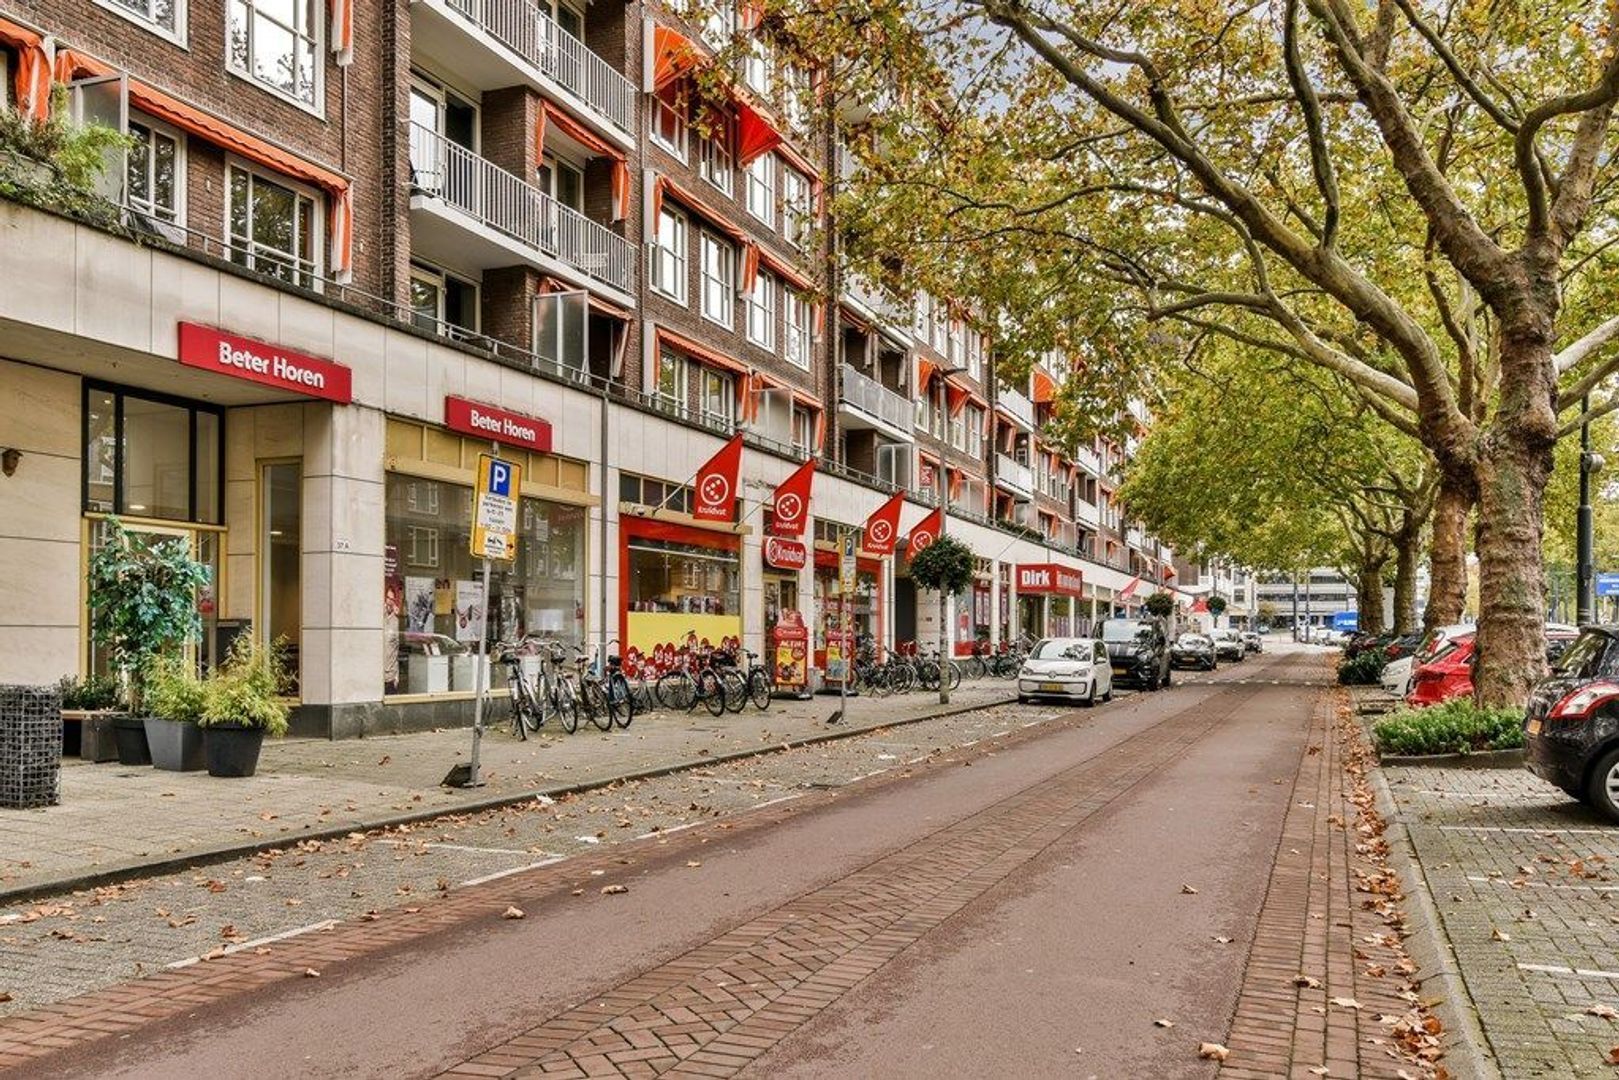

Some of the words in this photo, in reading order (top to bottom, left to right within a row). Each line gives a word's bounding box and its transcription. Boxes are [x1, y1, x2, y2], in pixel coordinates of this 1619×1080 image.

[218, 341, 269, 375] Beter
[273, 356, 324, 389] Horen
[470, 409, 502, 433] Beter
[503, 418, 536, 442] Horen
[492, 464, 506, 491] P
[697, 505, 727, 516] Kruidvat
[845, 539, 852, 556] P
[1021, 569, 1051, 587] Dirk
